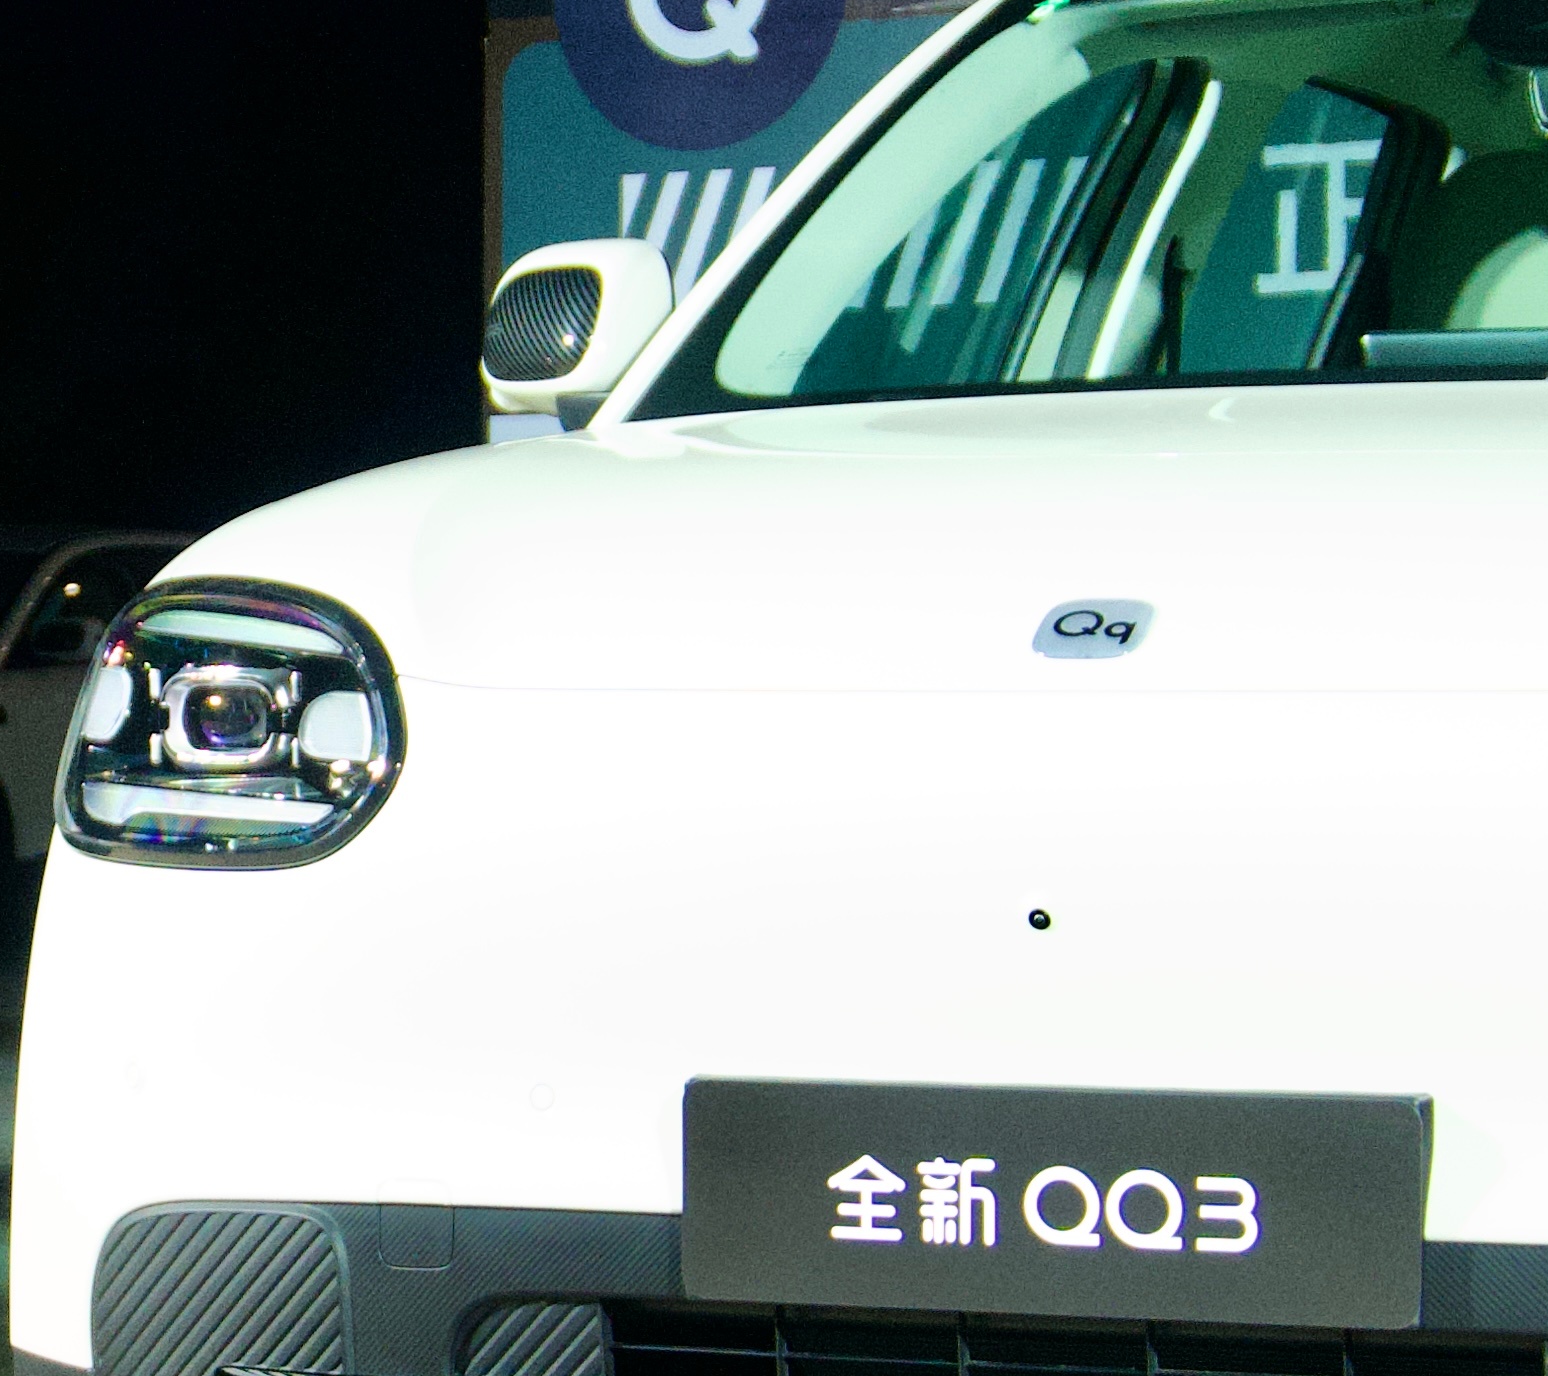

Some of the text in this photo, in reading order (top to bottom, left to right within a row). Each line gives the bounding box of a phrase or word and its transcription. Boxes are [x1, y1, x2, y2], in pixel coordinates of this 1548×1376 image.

[1053, 609, 1137, 645] Qq
[827, 1154, 1260, 1254] 全新 QQ3
